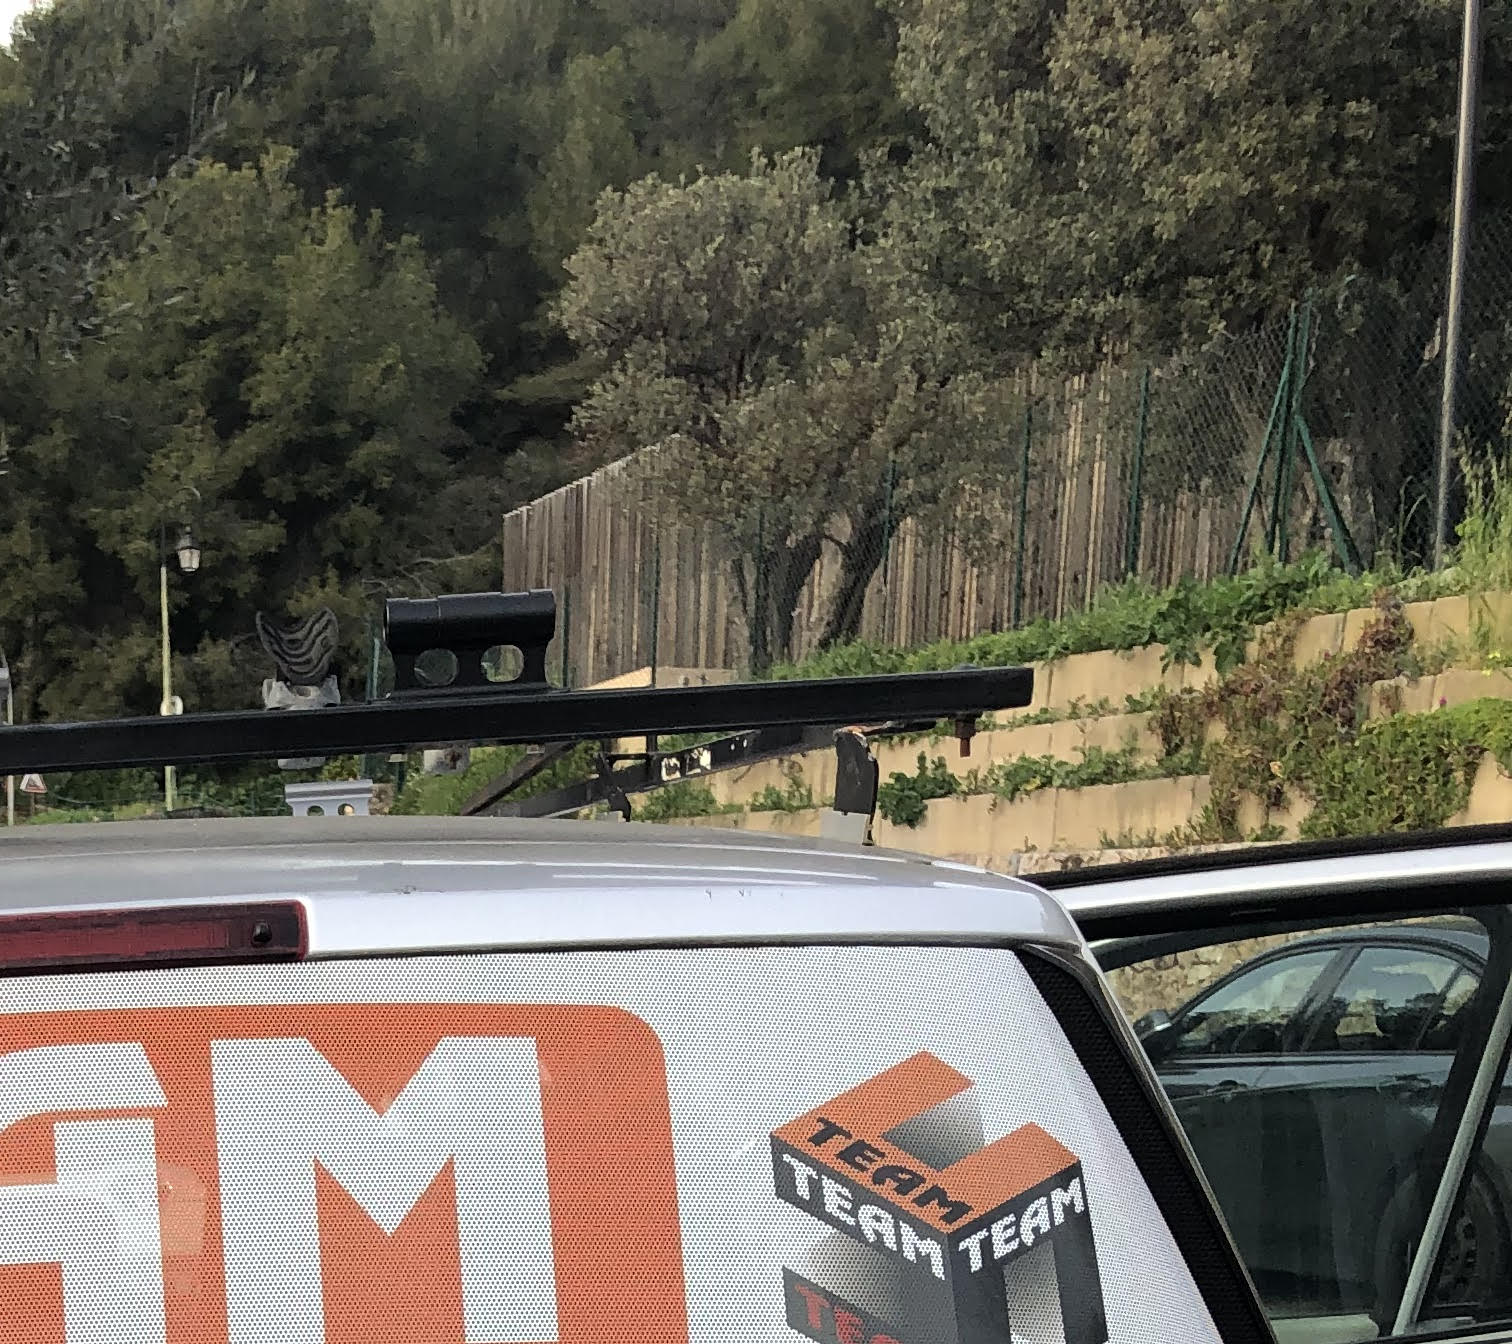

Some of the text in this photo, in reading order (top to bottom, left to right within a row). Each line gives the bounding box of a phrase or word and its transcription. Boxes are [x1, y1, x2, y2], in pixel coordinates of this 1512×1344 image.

[782, 1153, 946, 1281] TEAM
[806, 1116, 975, 1225] TEAM
[958, 1176, 1086, 1274] TEAM
